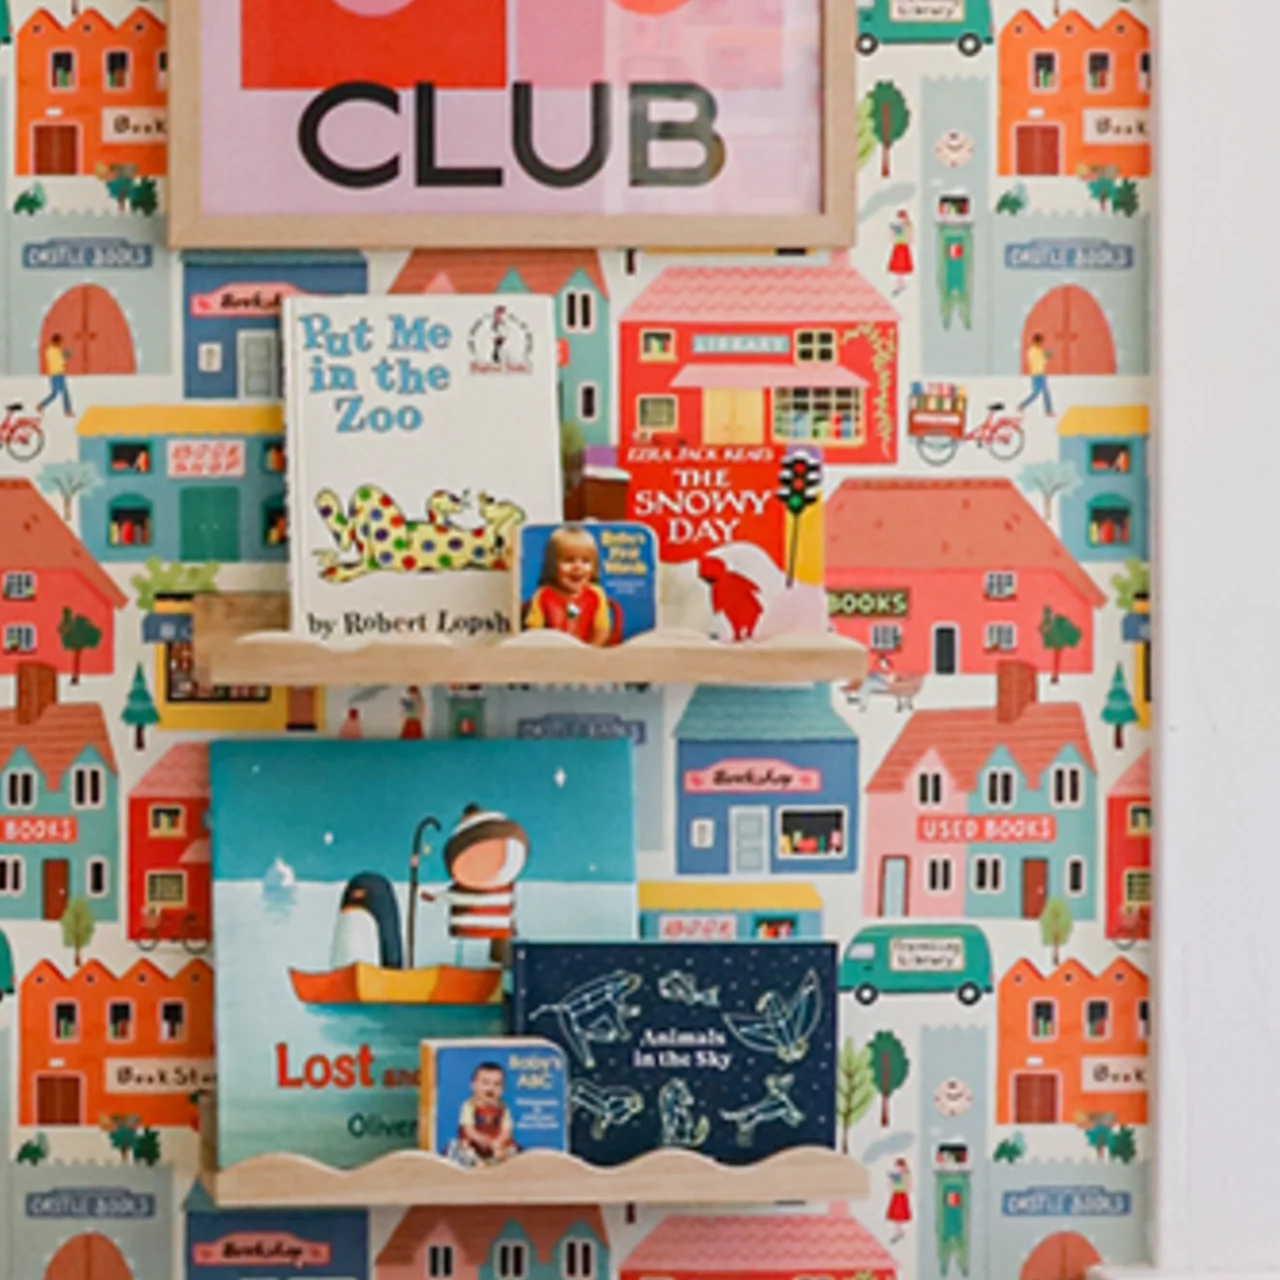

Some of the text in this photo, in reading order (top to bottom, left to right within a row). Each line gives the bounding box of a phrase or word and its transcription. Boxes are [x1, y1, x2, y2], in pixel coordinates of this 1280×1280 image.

[296, 80, 727, 190] CLUB
[298, 312, 373, 357] Put
[387, 314, 452, 353] Me
[697, 336, 784, 352] LIBRARY
[309, 355, 451, 394] in the
[334, 395, 424, 433] Zoo
[673, 468, 731, 487] THE
[634, 489, 771, 517] SNOWY
[669, 518, 740, 544] DAY
[825, 593, 908, 611] BOOKS
[306, 611, 335, 640] by
[343, 610, 426, 635] Robert
[4, 817, 72, 840] BOOKS
[921, 816, 1052, 840] USED BOOKS
[639, 1028, 726, 1048] Animals
[275, 1041, 376, 1090] Lost
[633, 1049, 732, 1070] in the Sky
[517, 1074, 553, 1090] ABC
